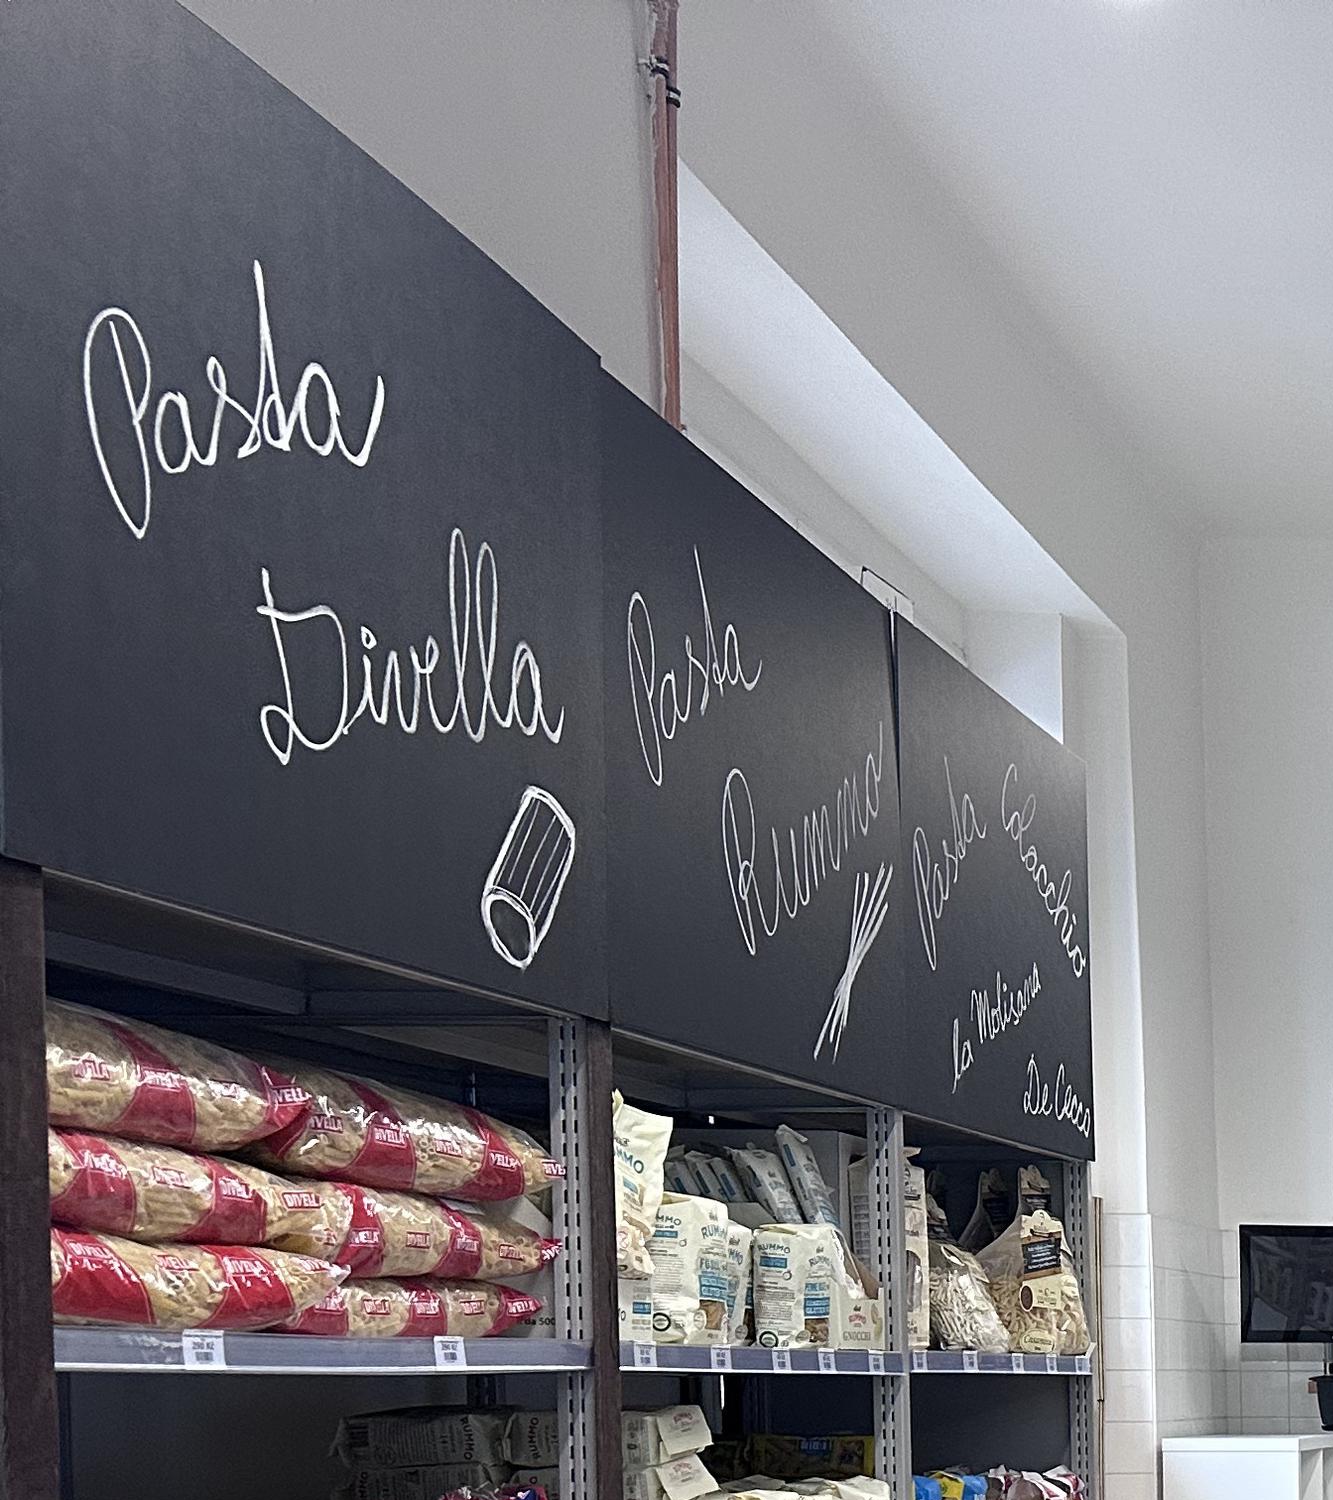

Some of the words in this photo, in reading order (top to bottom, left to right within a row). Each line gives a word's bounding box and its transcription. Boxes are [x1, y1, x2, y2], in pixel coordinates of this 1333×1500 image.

[84, 260, 385, 539] Pasta
[257, 529, 564, 766] Divella
[627, 544, 762, 786] Pasta
[914, 755, 986, 970] Pasta
[1024, 1054, 1052, 1117] De
[1055, 1064, 1090, 1137] Cecco
